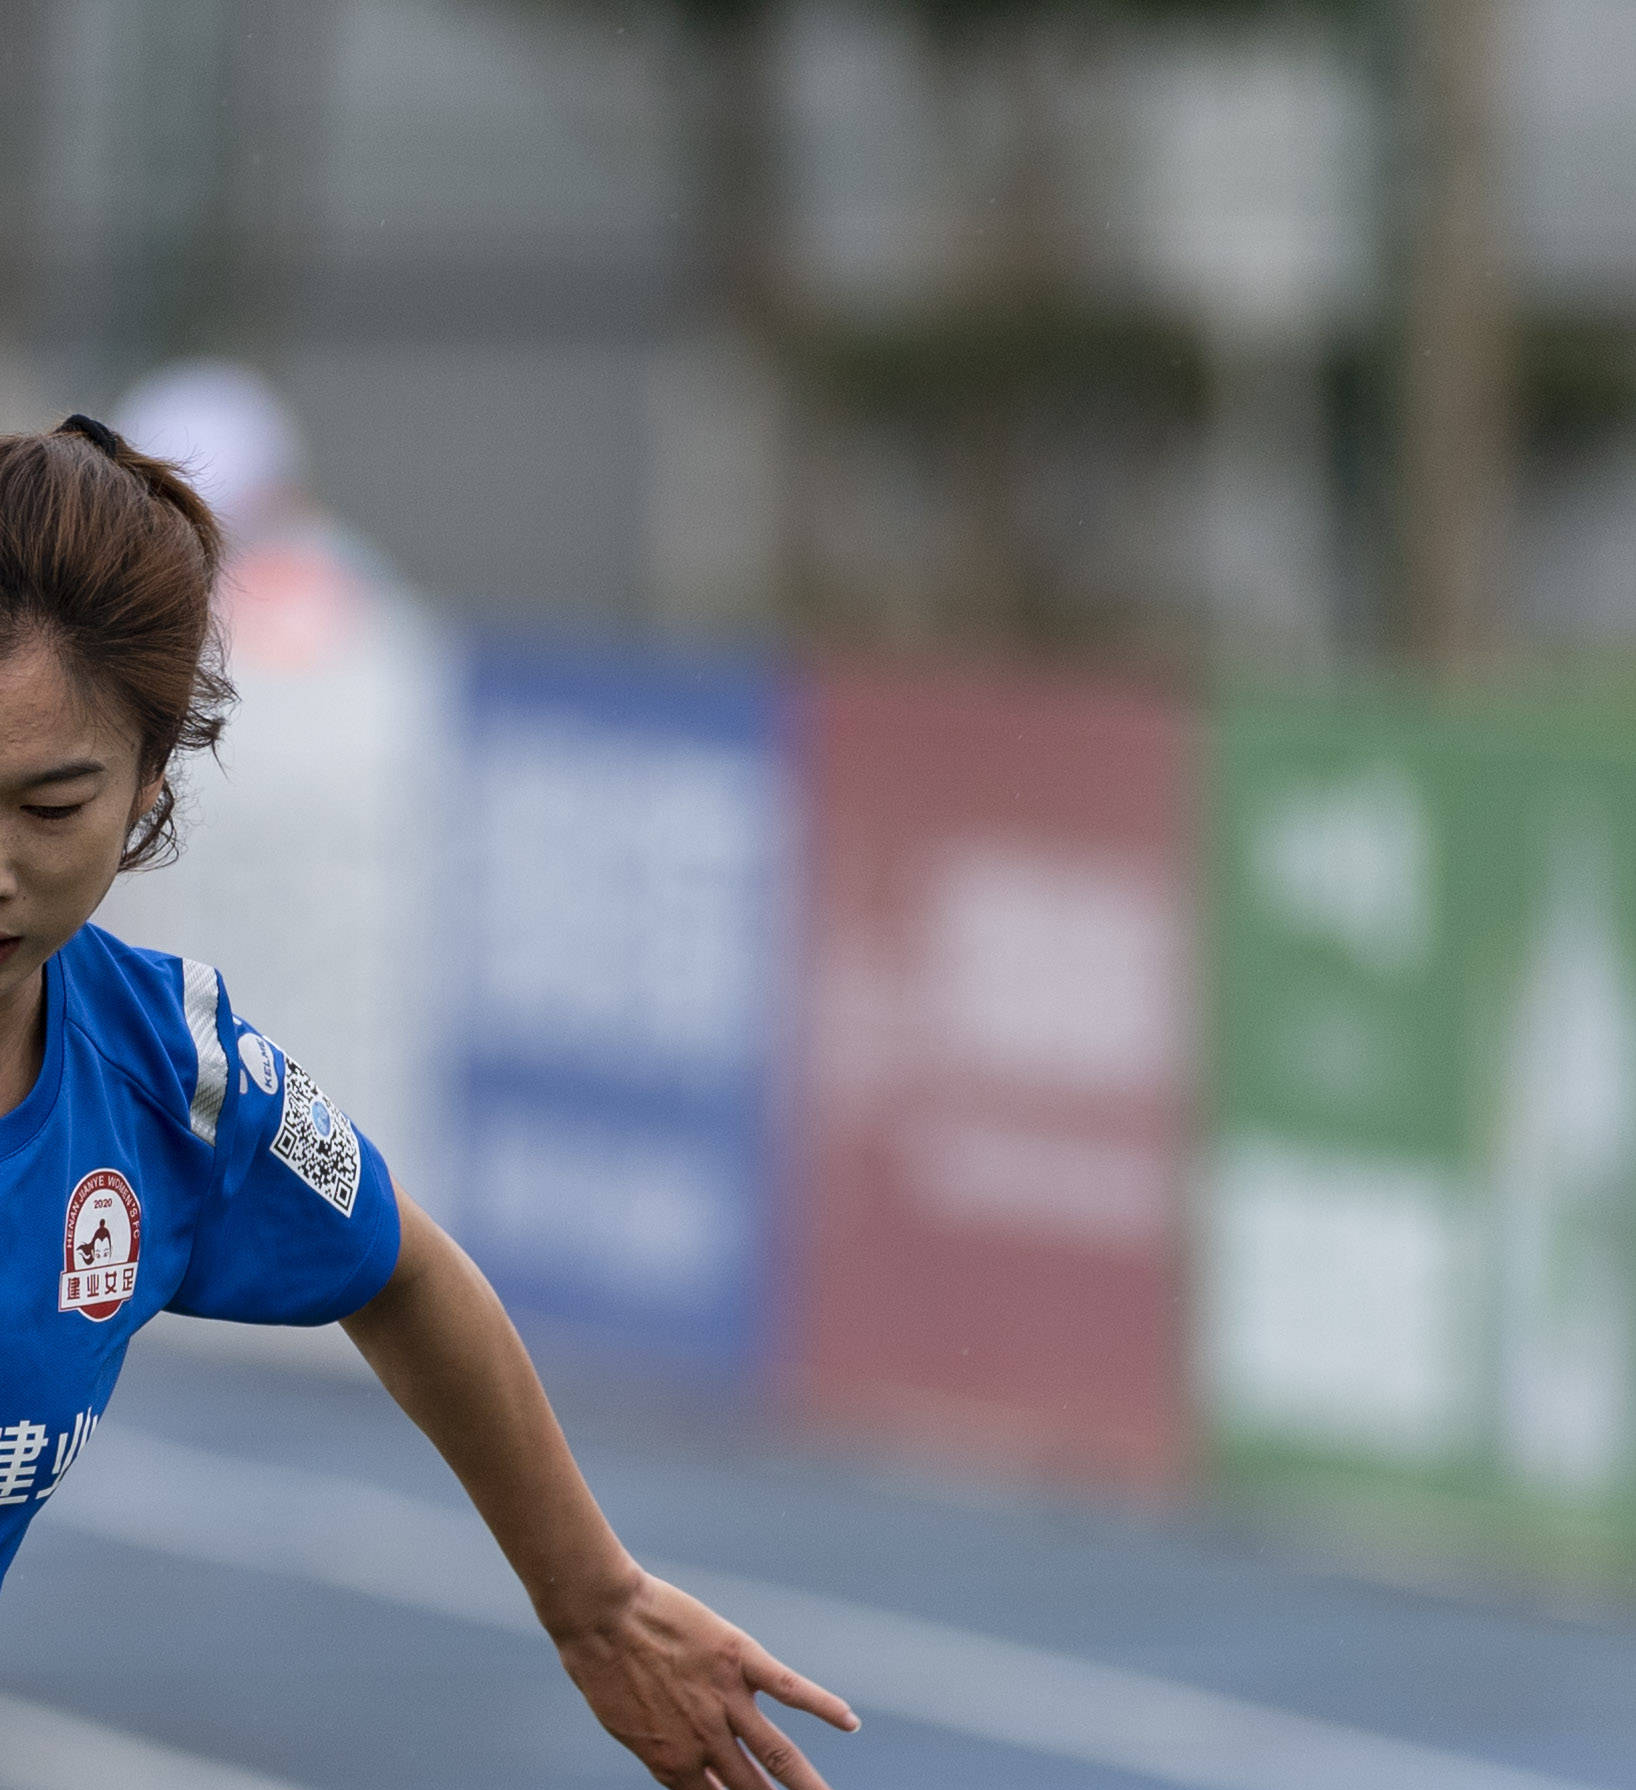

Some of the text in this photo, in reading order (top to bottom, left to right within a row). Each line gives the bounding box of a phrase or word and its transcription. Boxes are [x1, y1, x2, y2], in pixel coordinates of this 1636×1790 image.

[256, 1037, 273, 1088] KELME
[66, 1202, 80, 1248] HENAN
[78, 1175, 105, 1203] JIANYE
[133, 1220, 141, 1239] FC
[93, 1198, 113, 1209] 2020
[67, 1267, 134, 1300] 建业女足
